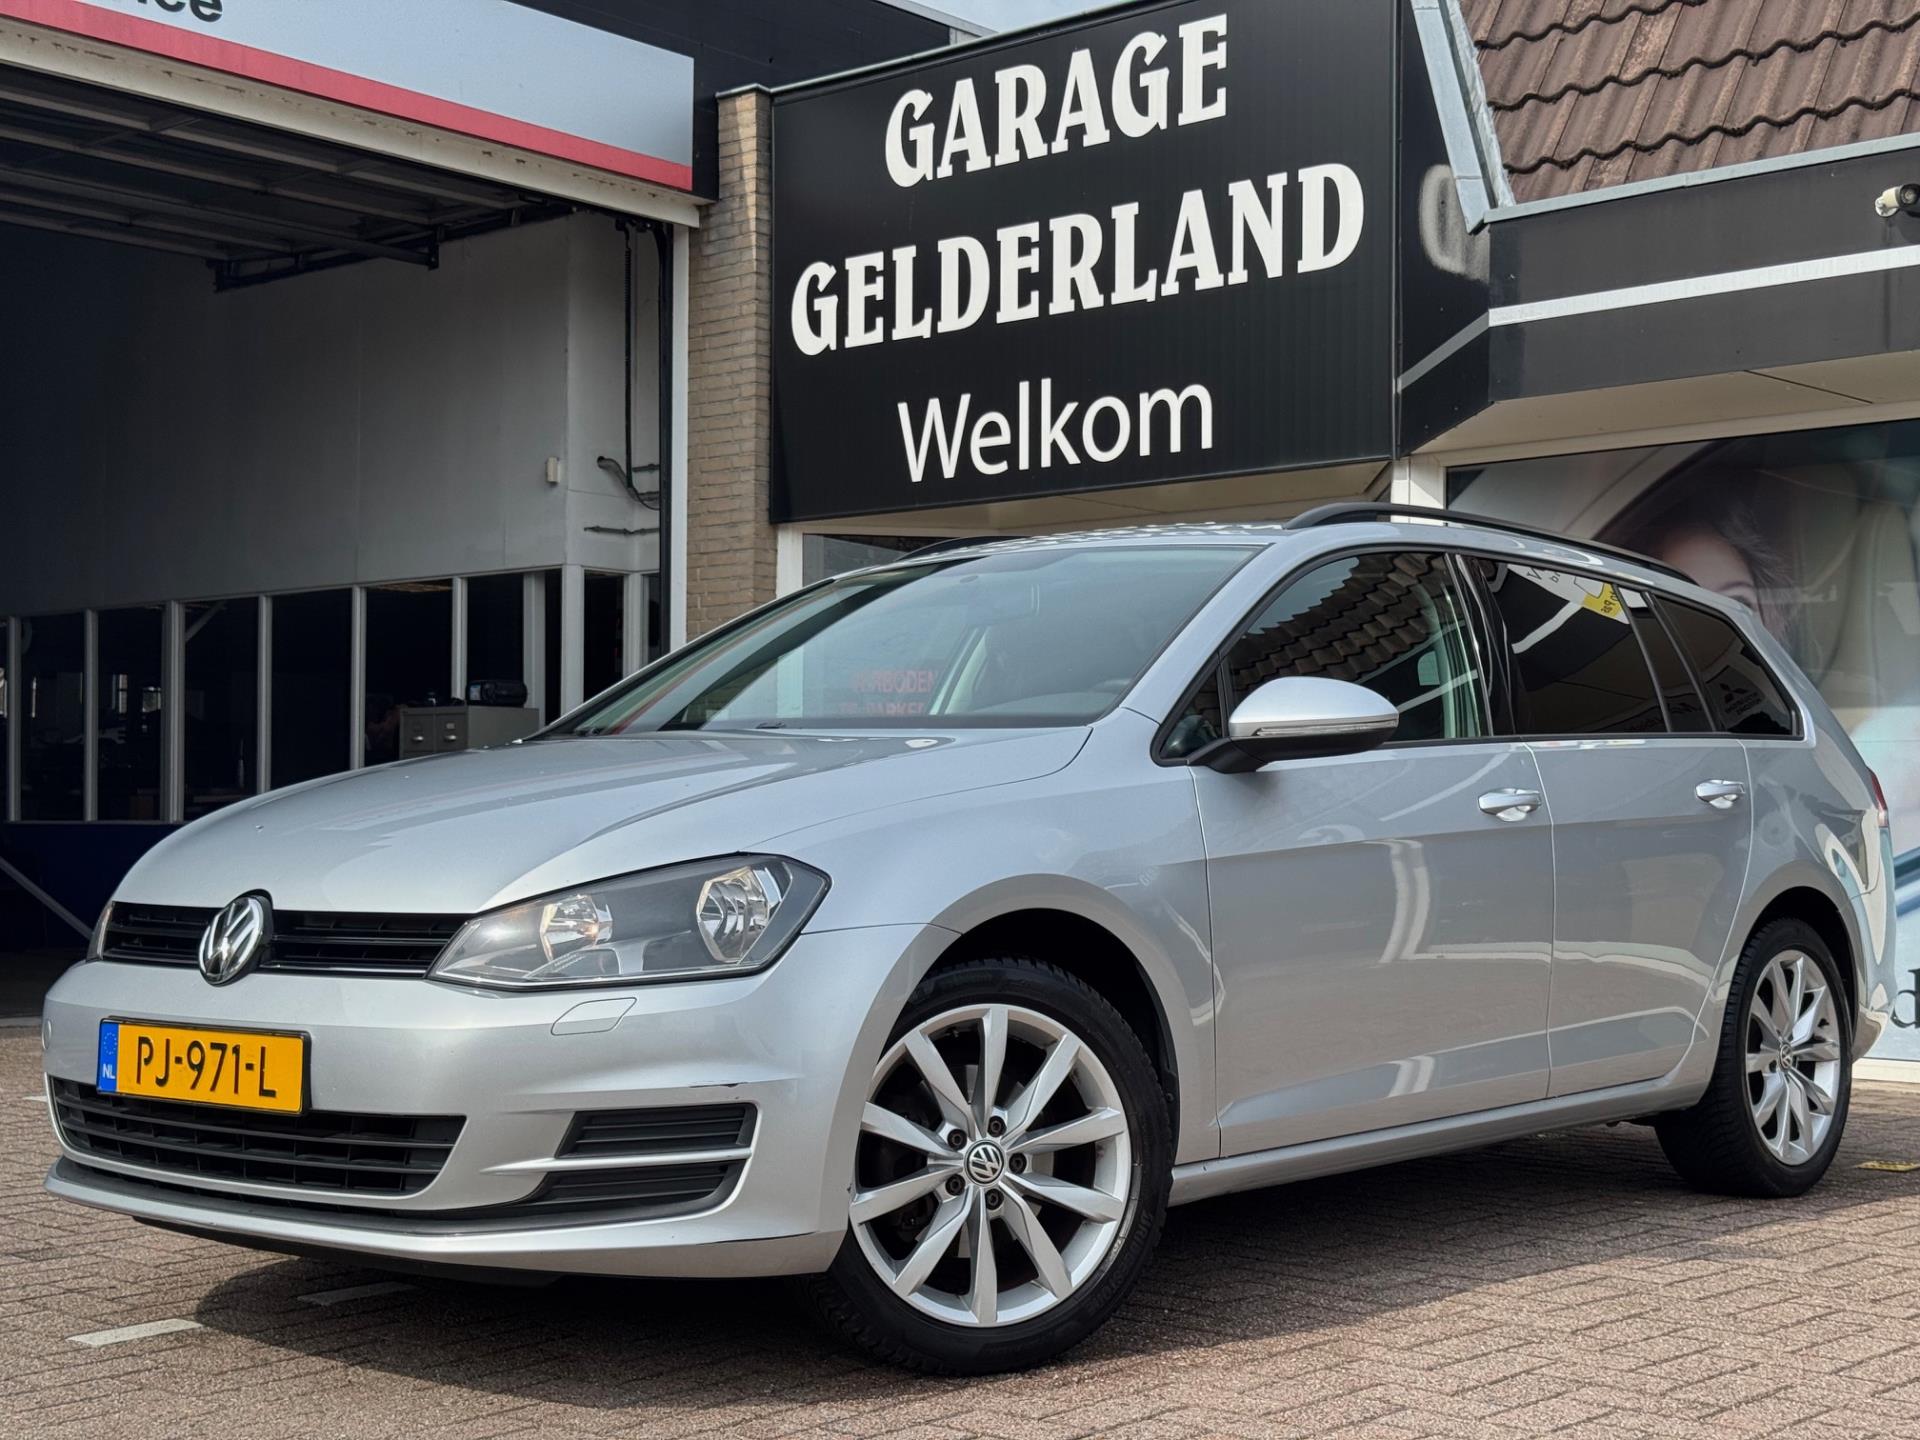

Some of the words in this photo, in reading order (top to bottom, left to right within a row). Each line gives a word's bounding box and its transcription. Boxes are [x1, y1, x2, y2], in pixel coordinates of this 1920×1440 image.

[885, 13, 1228, 188] GARAGE
[791, 163, 1365, 356] GELDERLAND
[897, 378, 1213, 483] Welkom
[851, 671, 938, 692] RBODEN
[102, 1063, 116, 1080] NL
[136, 1035, 277, 1098] PJ-971-L
